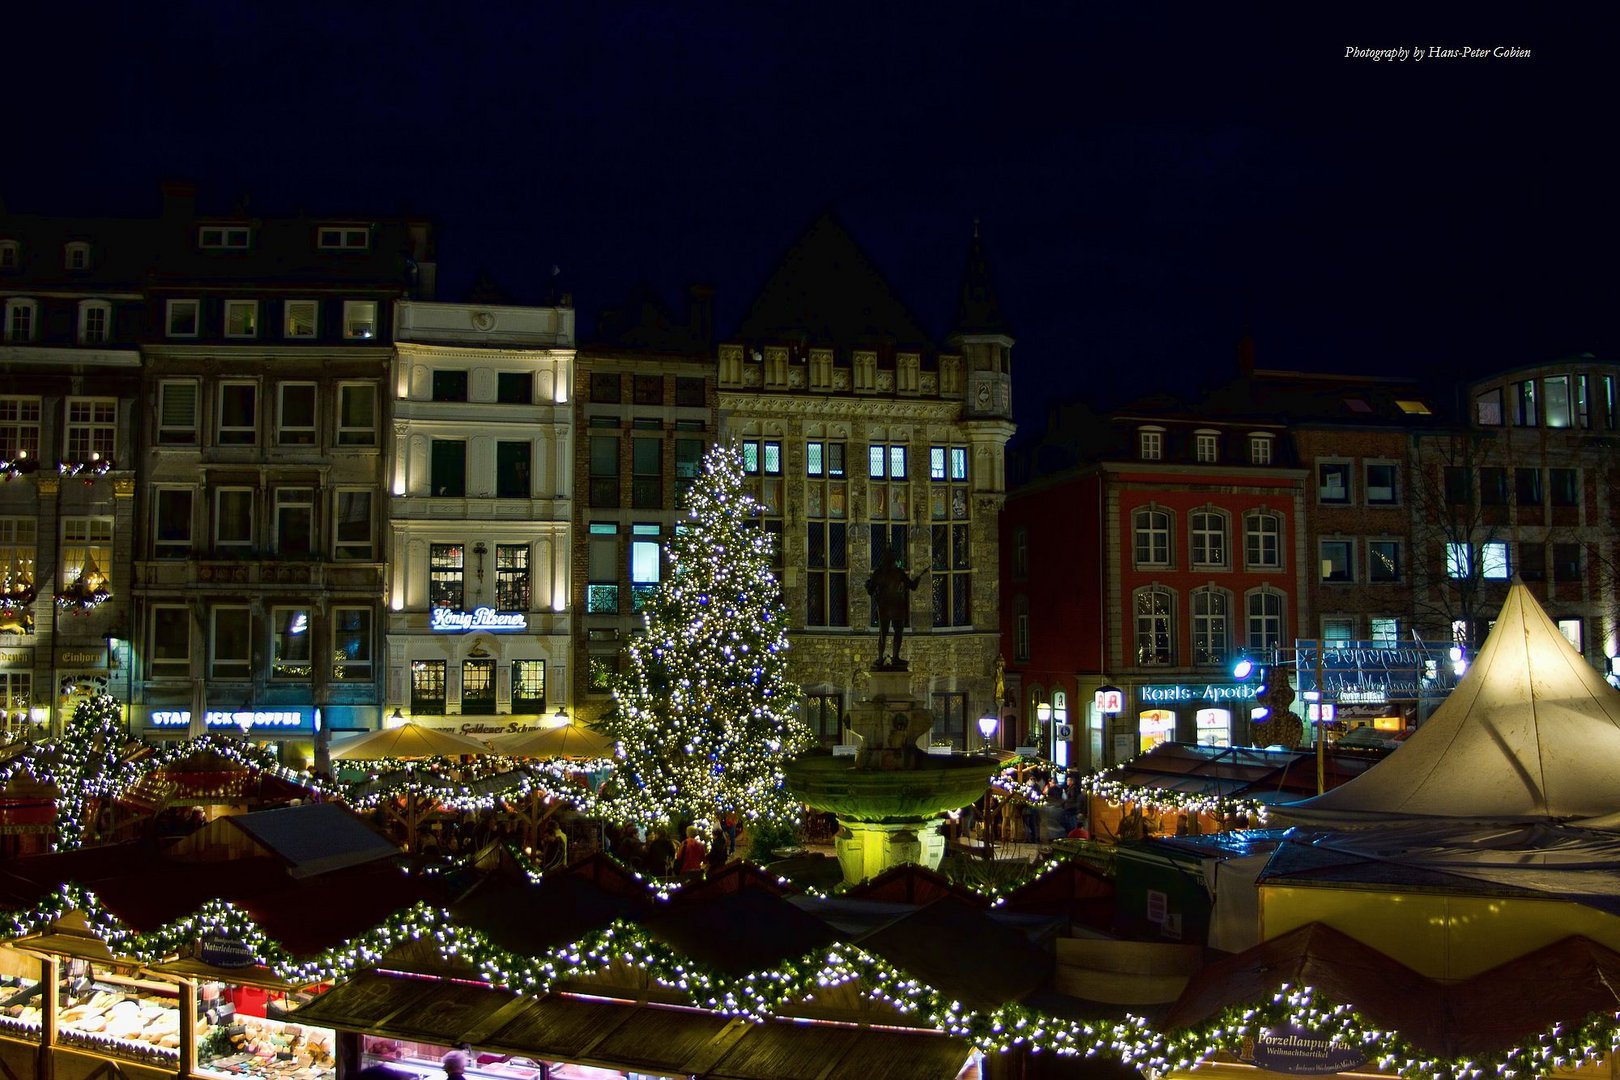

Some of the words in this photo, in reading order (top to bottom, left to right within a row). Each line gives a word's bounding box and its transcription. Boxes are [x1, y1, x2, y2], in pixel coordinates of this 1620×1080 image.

[432, 607, 526, 629] König-Pilsener
[460, 722, 506, 736] Goldener
[0, 825, 56, 835] HWEIN
[1257, 1033, 1352, 1053] Porzellanpuppen
[1266, 1047, 1329, 1059] Weihnachtsartikel
